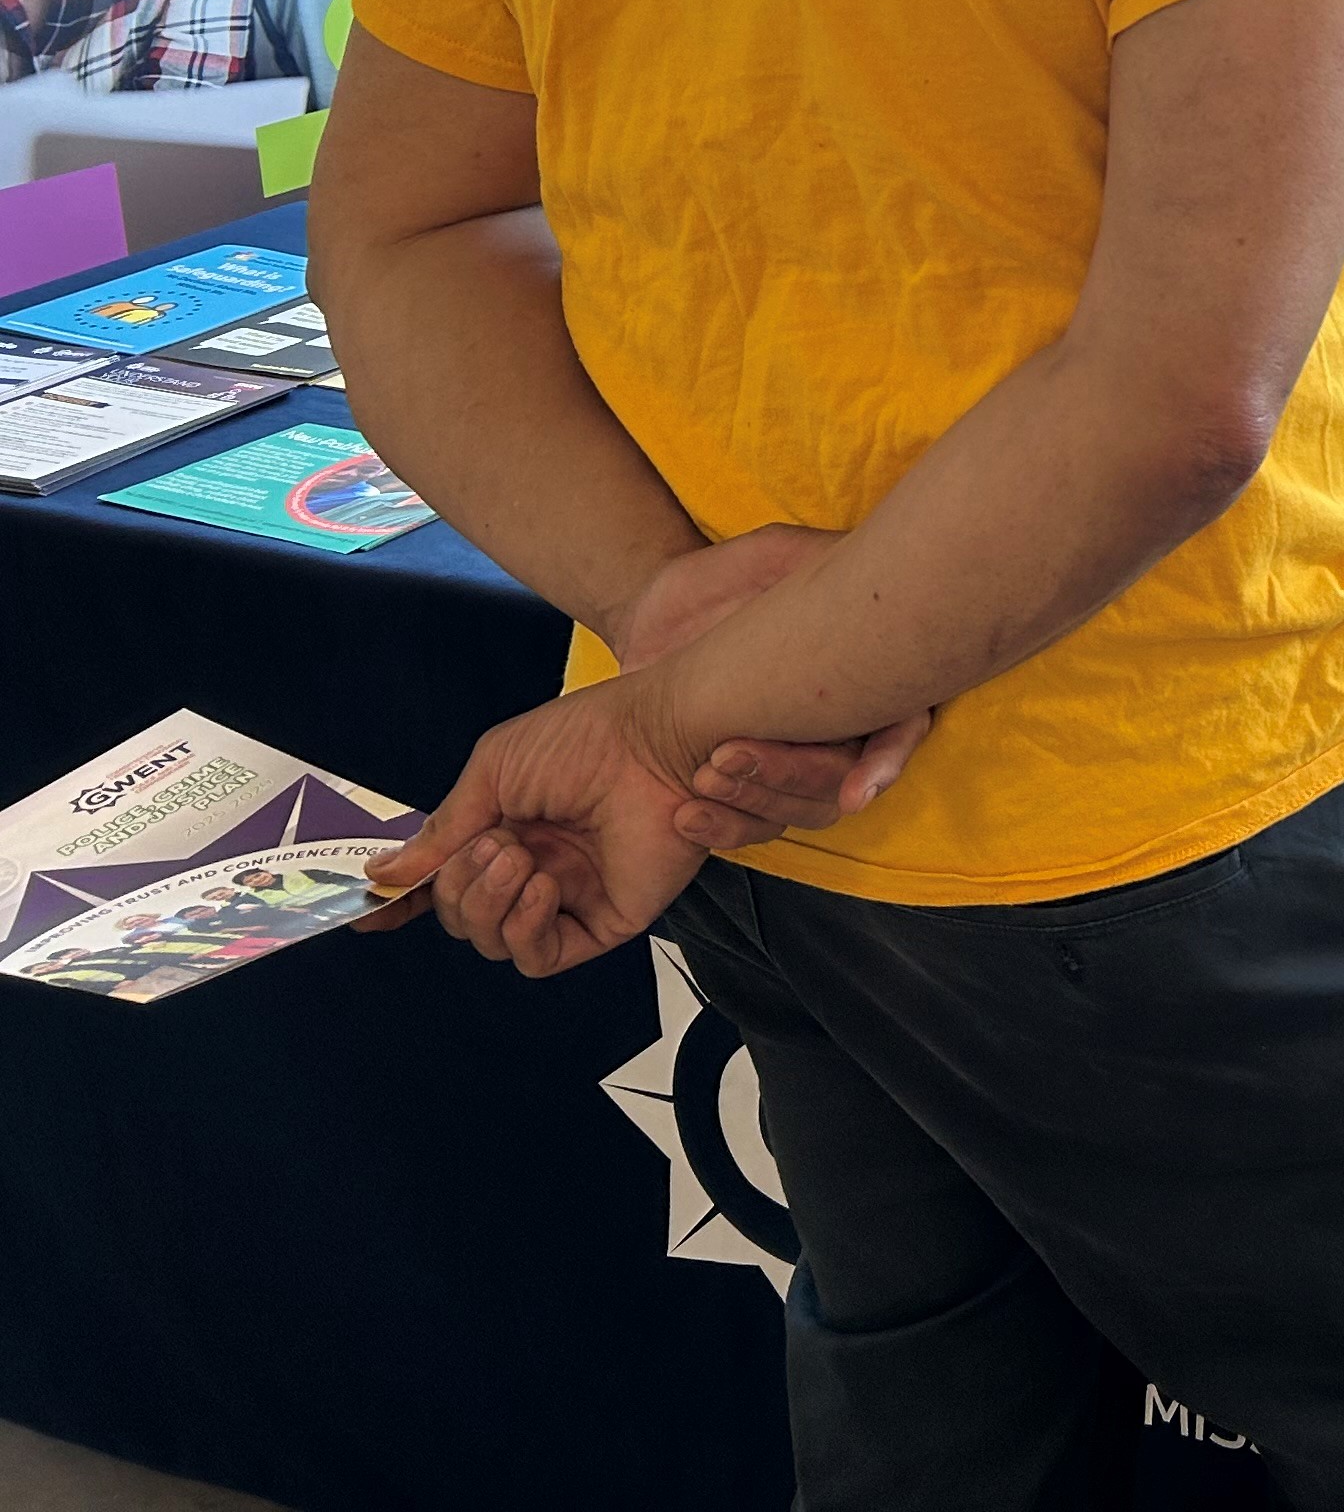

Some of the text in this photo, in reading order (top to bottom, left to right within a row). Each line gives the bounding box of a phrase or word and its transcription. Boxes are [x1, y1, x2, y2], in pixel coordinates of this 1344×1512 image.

[86, 741, 191, 806] GWENT
[152, 756, 230, 804] CRIME
[192, 770, 258, 811] PLAN
[93, 822, 147, 855] AND
[148, 763, 245, 825] JUSTICE
[115, 882, 171, 910] TRUST
[179, 870, 217, 888] AND
[224, 846, 340, 874] CONFIDENCE
